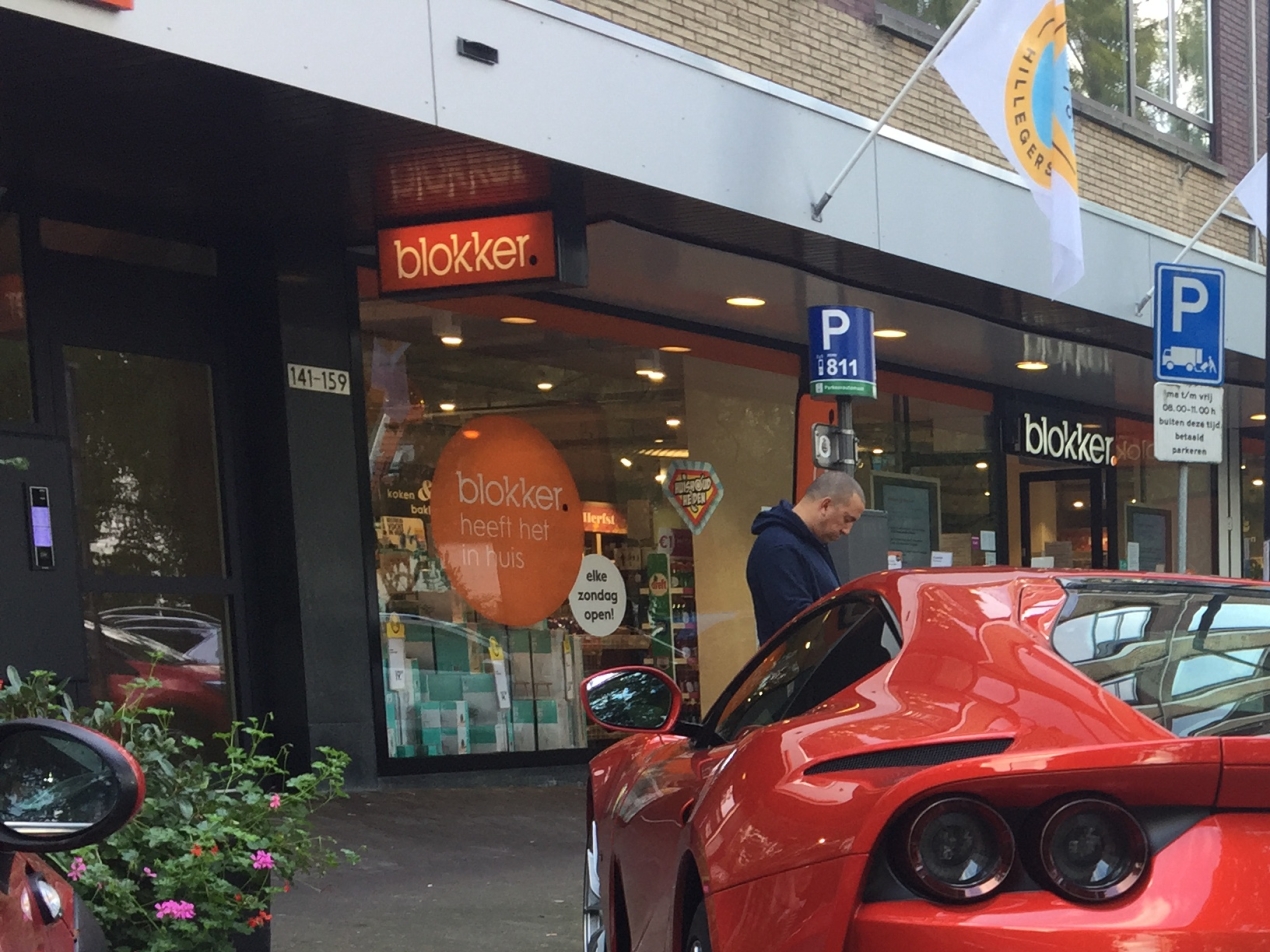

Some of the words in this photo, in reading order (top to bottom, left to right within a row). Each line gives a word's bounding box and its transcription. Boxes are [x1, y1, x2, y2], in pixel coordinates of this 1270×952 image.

[1172, 276, 1209, 332] P
[821, 309, 850, 350] P
[826, 358, 858, 377] 811
[290, 366, 347, 392] 141-159
[1181, 391, 1197, 399] t/m
[1199, 393, 1213, 404] vrij
[1211, 407, 1216, 415] h
[1159, 417, 1185, 427] buiten
[1186, 420, 1205, 428] deze
[1175, 432, 1204, 442] betaald
[1172, 446, 1207, 455] parkeren
[387, 489, 415, 500] koken
[460, 513, 511, 538] heeft
[519, 518, 549, 541] het
[462, 543, 479, 566] in
[486, 546, 525, 569] huis
[586, 570, 608, 583] elke
[577, 590, 618, 605] zondag
[584, 608, 615, 623] open!
